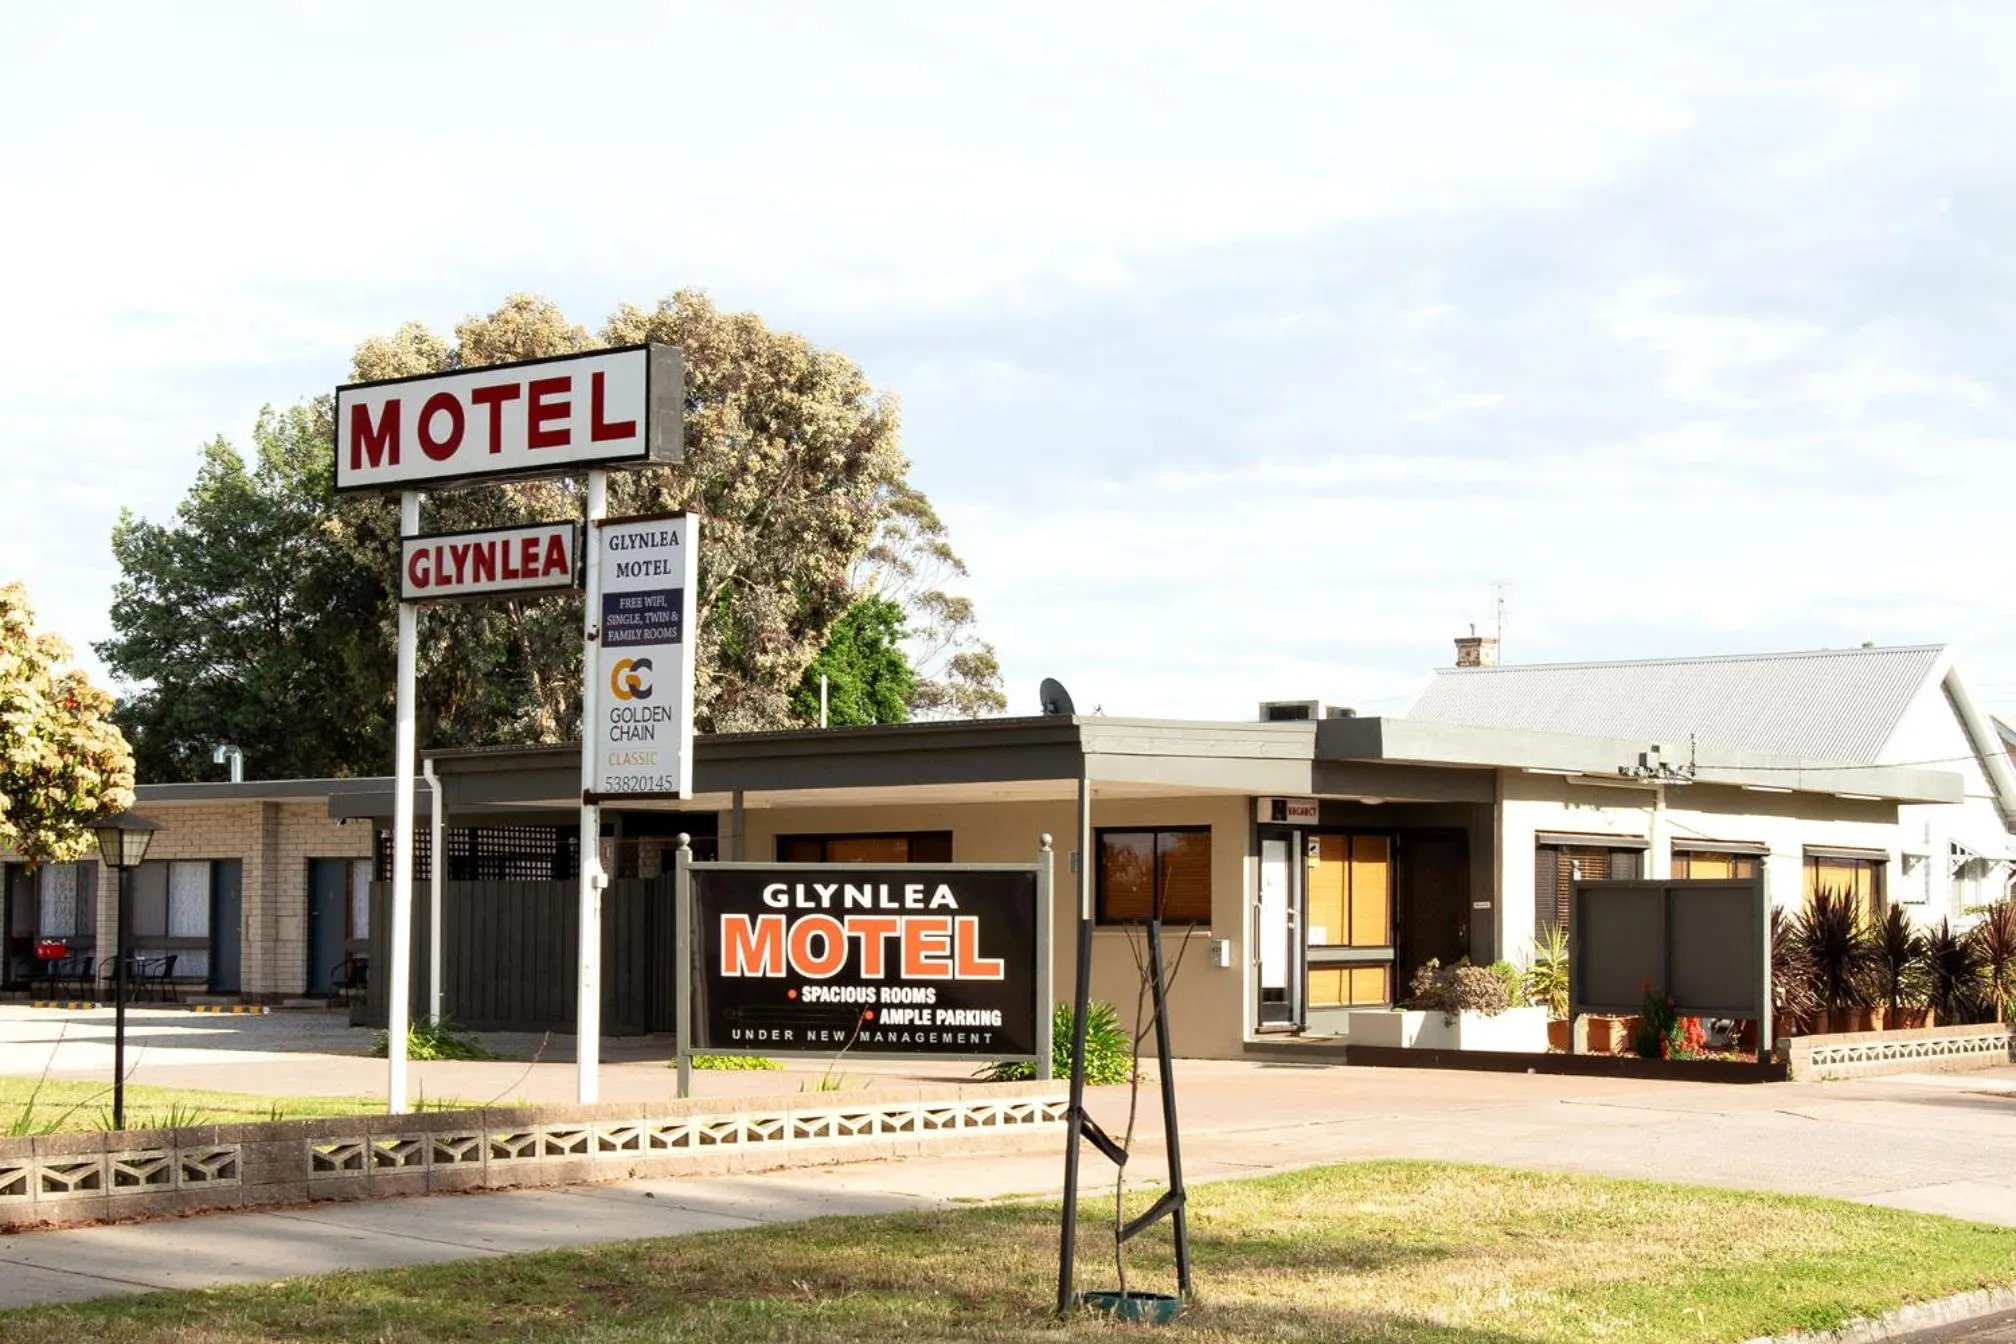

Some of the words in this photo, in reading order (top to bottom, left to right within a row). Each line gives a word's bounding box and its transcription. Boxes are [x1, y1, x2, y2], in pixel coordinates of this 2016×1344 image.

[350, 371, 637, 470] MOTEL
[609, 530, 680, 551] GLYNLEA
[408, 534, 569, 589] GLYNLEA
[616, 559, 672, 578] MOTEL
[620, 597, 643, 609] FREE
[607, 613, 643, 626] SINGLE,
[645, 611, 670, 624] TWIN
[671, 611, 679, 622] &
[608, 629, 642, 642] FAMILY
[643, 627, 677, 640] ROOMS
[610, 706, 672, 724] GOLDEN
[609, 725, 655, 742] CHAIN
[608, 752, 658, 766] CLASSIC
[605, 775, 673, 793] 53820145
[763, 884, 958, 909] GLYNLEA
[721, 913, 1005, 980] MOTEL
[802, 986, 876, 1004] SPACIOUS
[880, 987, 936, 1004] ROOMS
[879, 1008, 932, 1026] AMPLE
[936, 1009, 1002, 1027] PARKING
[732, 1028, 794, 1041] UNDER
[807, 1030, 846, 1042] NEW
[859, 1031, 993, 1044] MANAGEMENT
